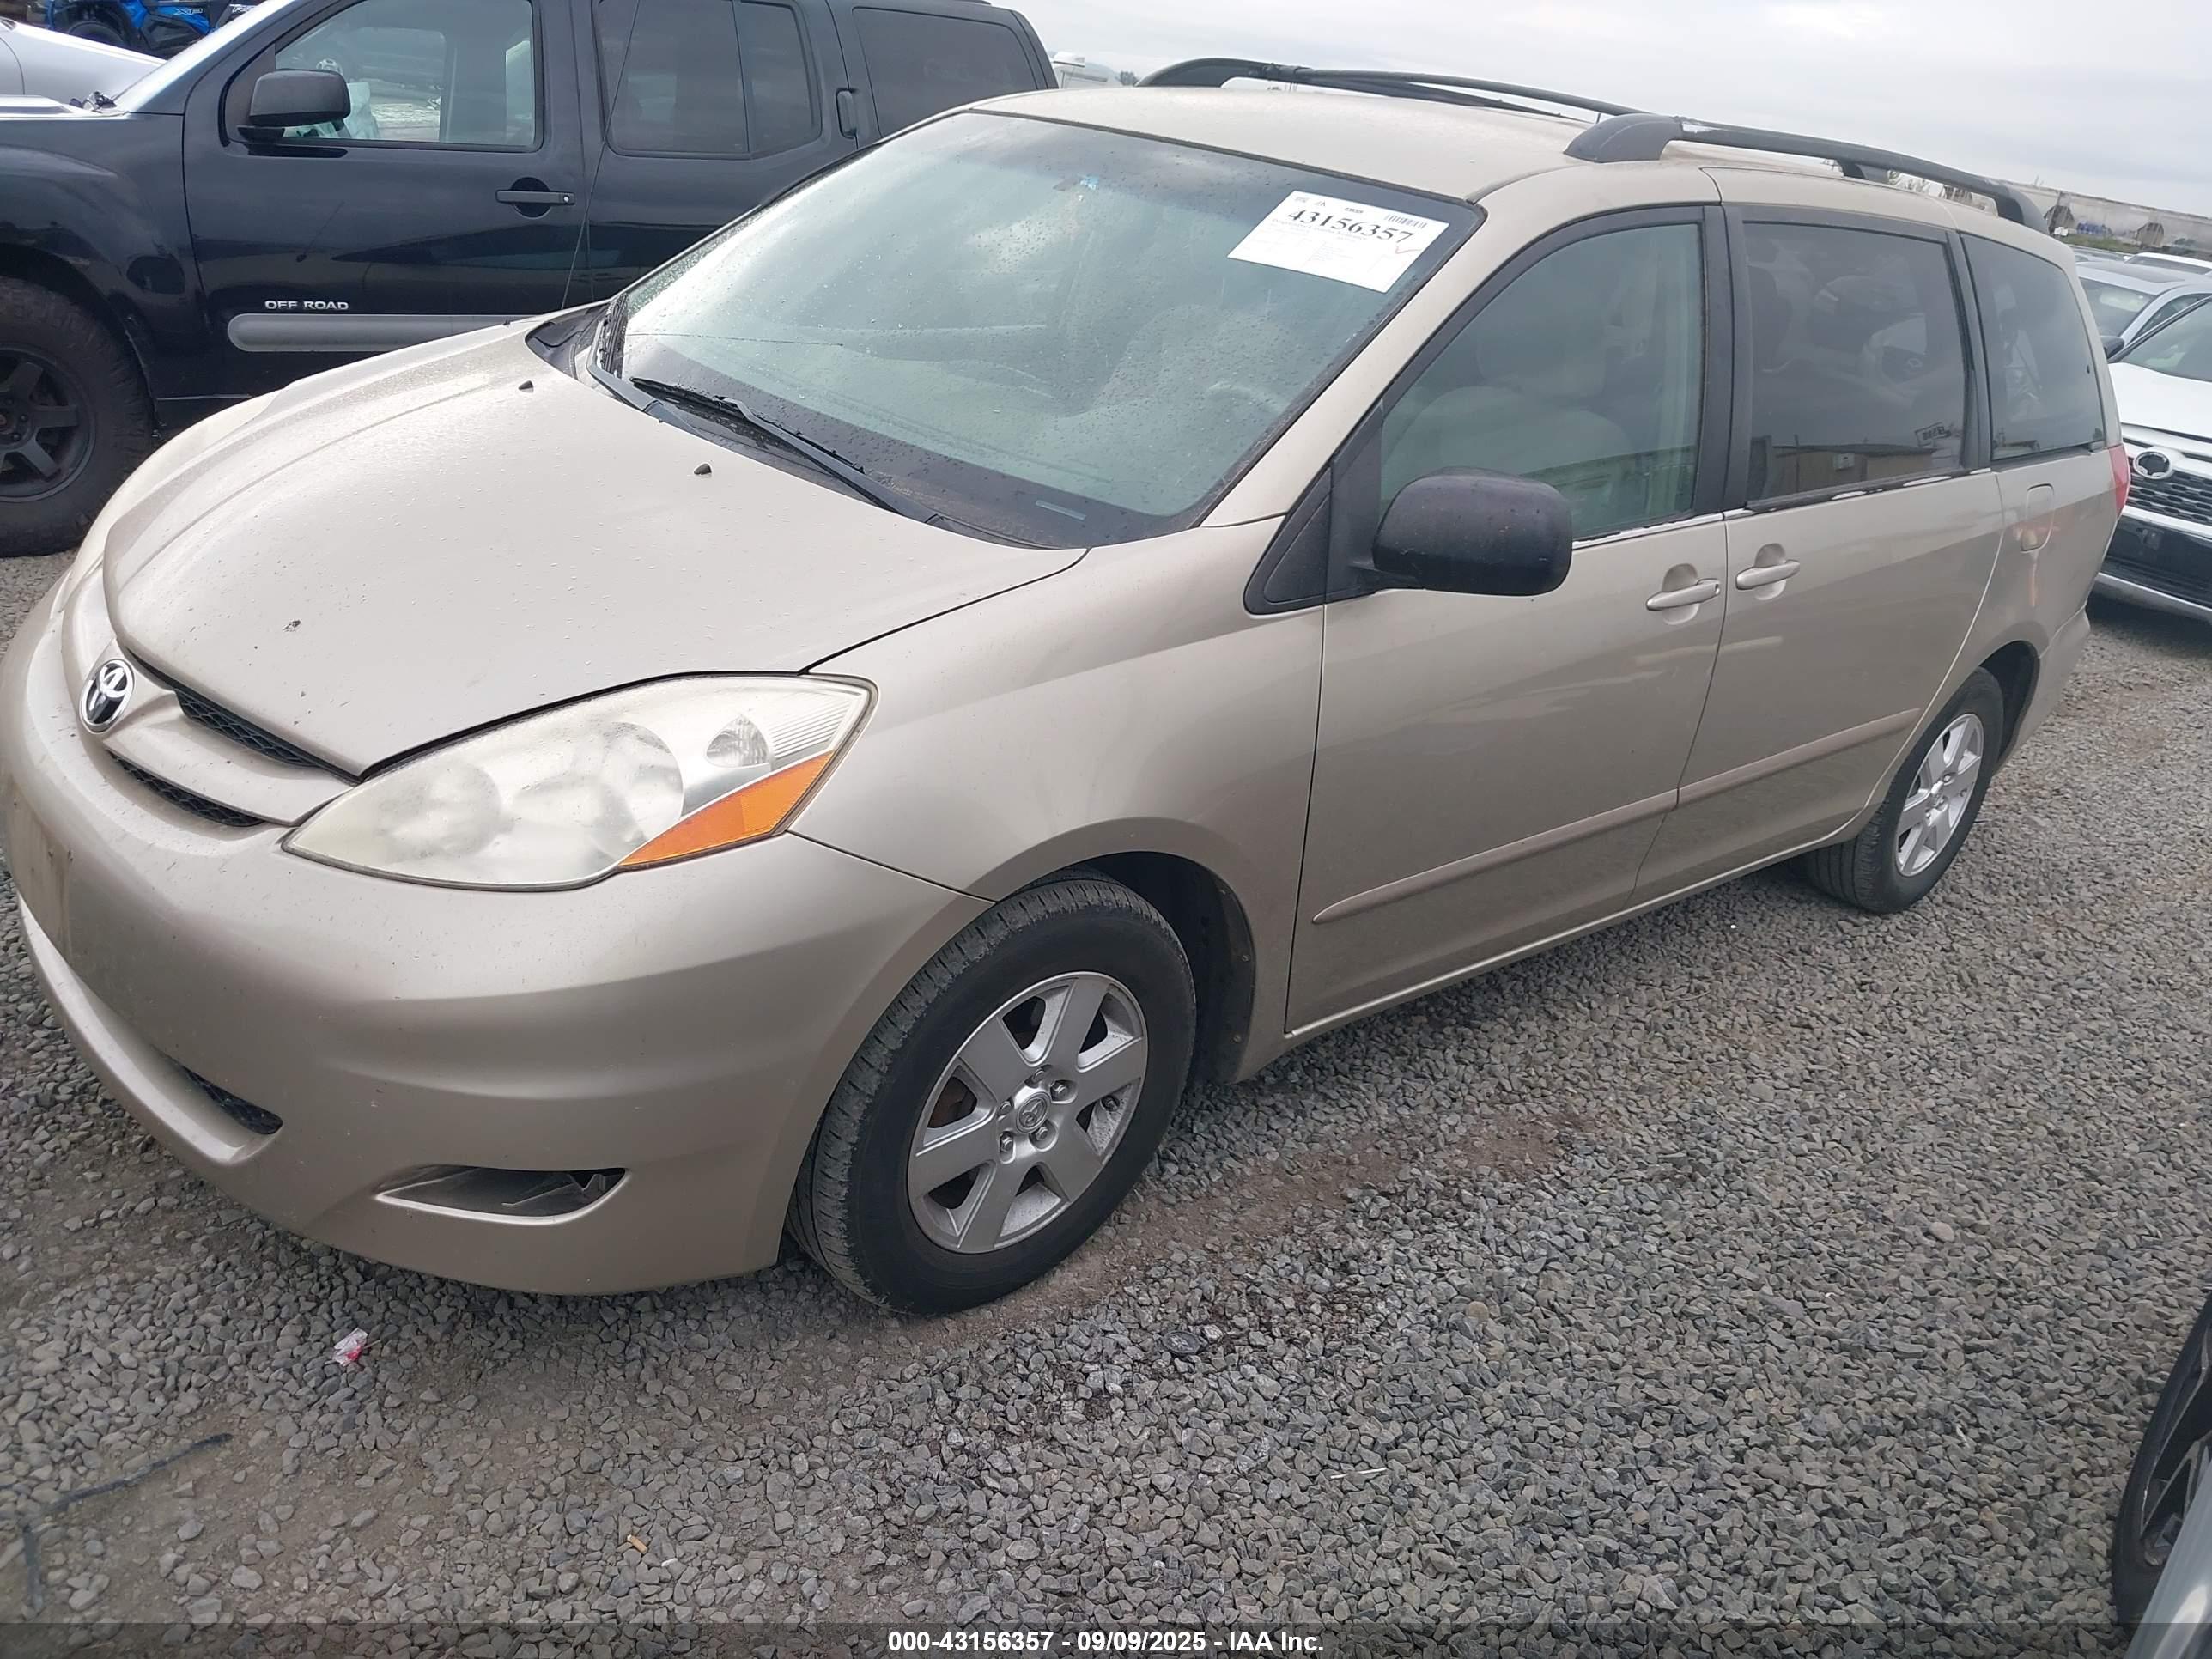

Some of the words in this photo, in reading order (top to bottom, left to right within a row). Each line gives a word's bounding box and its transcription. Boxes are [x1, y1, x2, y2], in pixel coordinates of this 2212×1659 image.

[1288, 209, 1415, 244] 43156357
[264, 301, 298, 310] OFF
[303, 301, 349, 310] ROAD
